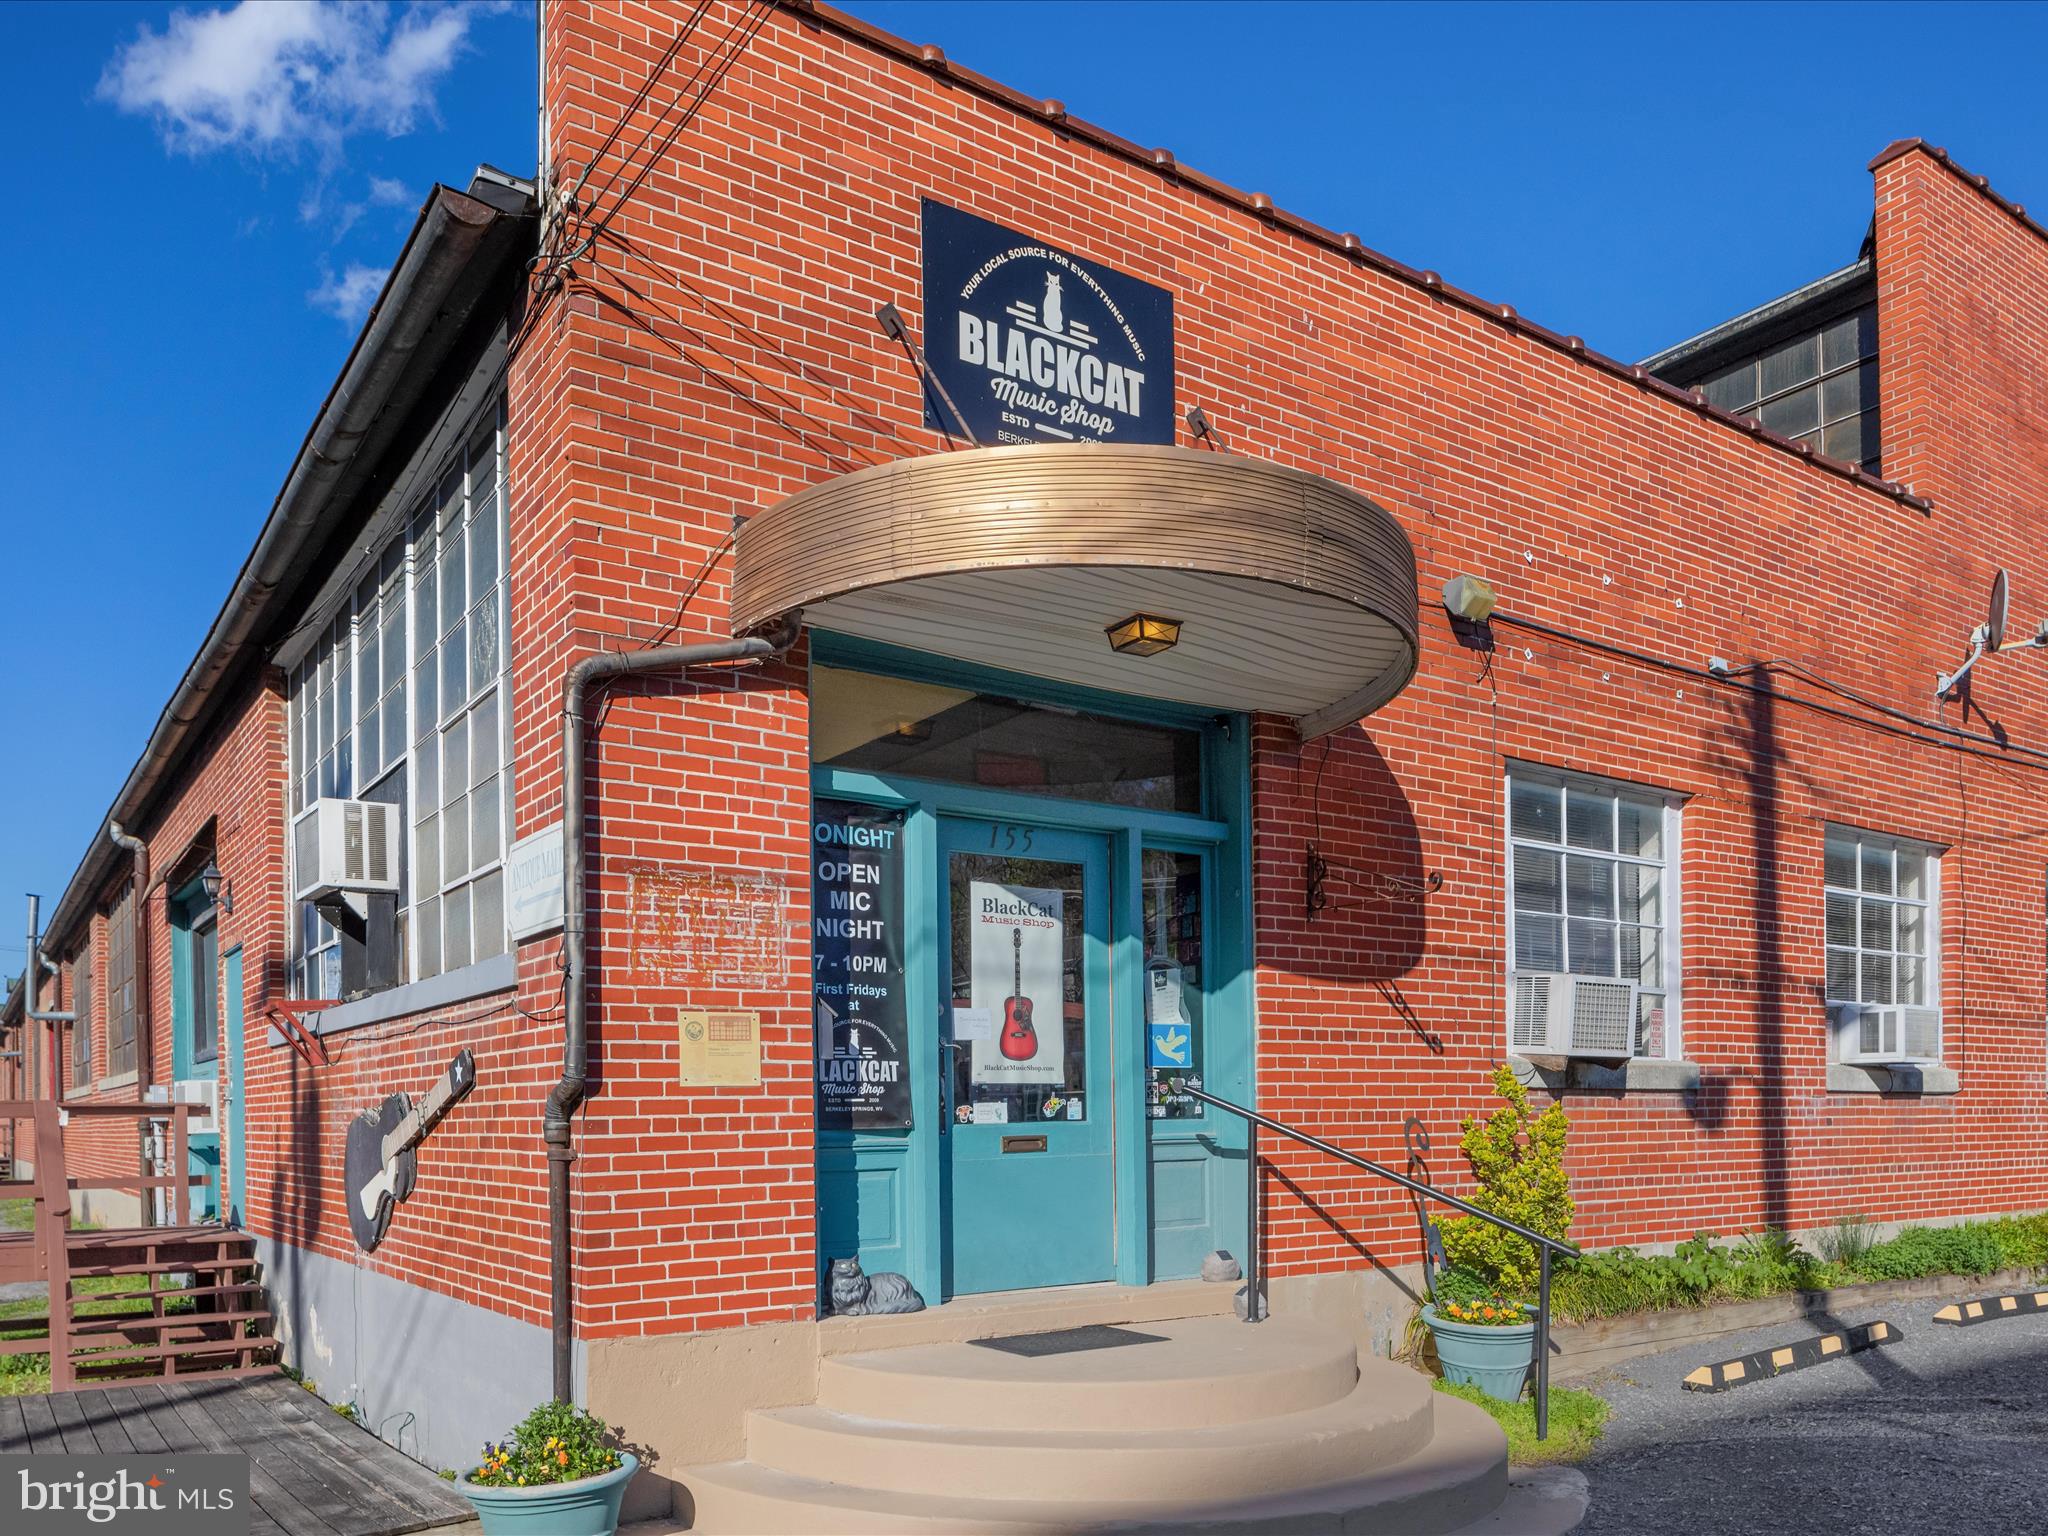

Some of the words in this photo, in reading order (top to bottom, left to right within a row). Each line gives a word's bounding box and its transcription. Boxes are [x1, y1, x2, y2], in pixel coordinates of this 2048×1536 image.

[961, 273, 983, 299] YOUR
[980, 253, 1008, 278] LOCAL
[1008, 246, 1047, 260] SOURCE
[1049, 251, 1068, 268] FOR
[1070, 262, 1124, 324] EVERYTHING
[1122, 324, 1145, 362] MUSIC
[959, 310, 1145, 417] BLACKCAT
[991, 377, 1058, 416] Music
[1060, 398, 1115, 436] Shop
[1002, 411, 1030, 428] ESTD
[815, 823, 895, 849] ONIGHT
[991, 824, 1034, 852] 155
[818, 861, 880, 885] OPEN
[830, 890, 871, 911] MIC
[982, 898, 1055, 918] BlackCat
[816, 917, 884, 940] NIGHT
[981, 915, 1020, 926] Music
[1022, 918, 1055, 928] Shop
[815, 954, 825, 970] 7
[842, 955, 887, 973] 10PM
[815, 982, 843, 995] First
[846, 983, 887, 999] Fridays
[848, 1000, 860, 1011] at
[862, 1019, 887, 1039] EVERYTHING
[819, 1060, 899, 1082] LACKCAT
[822, 1083, 857, 1096] Music
[858, 1082, 886, 1096] Shop
